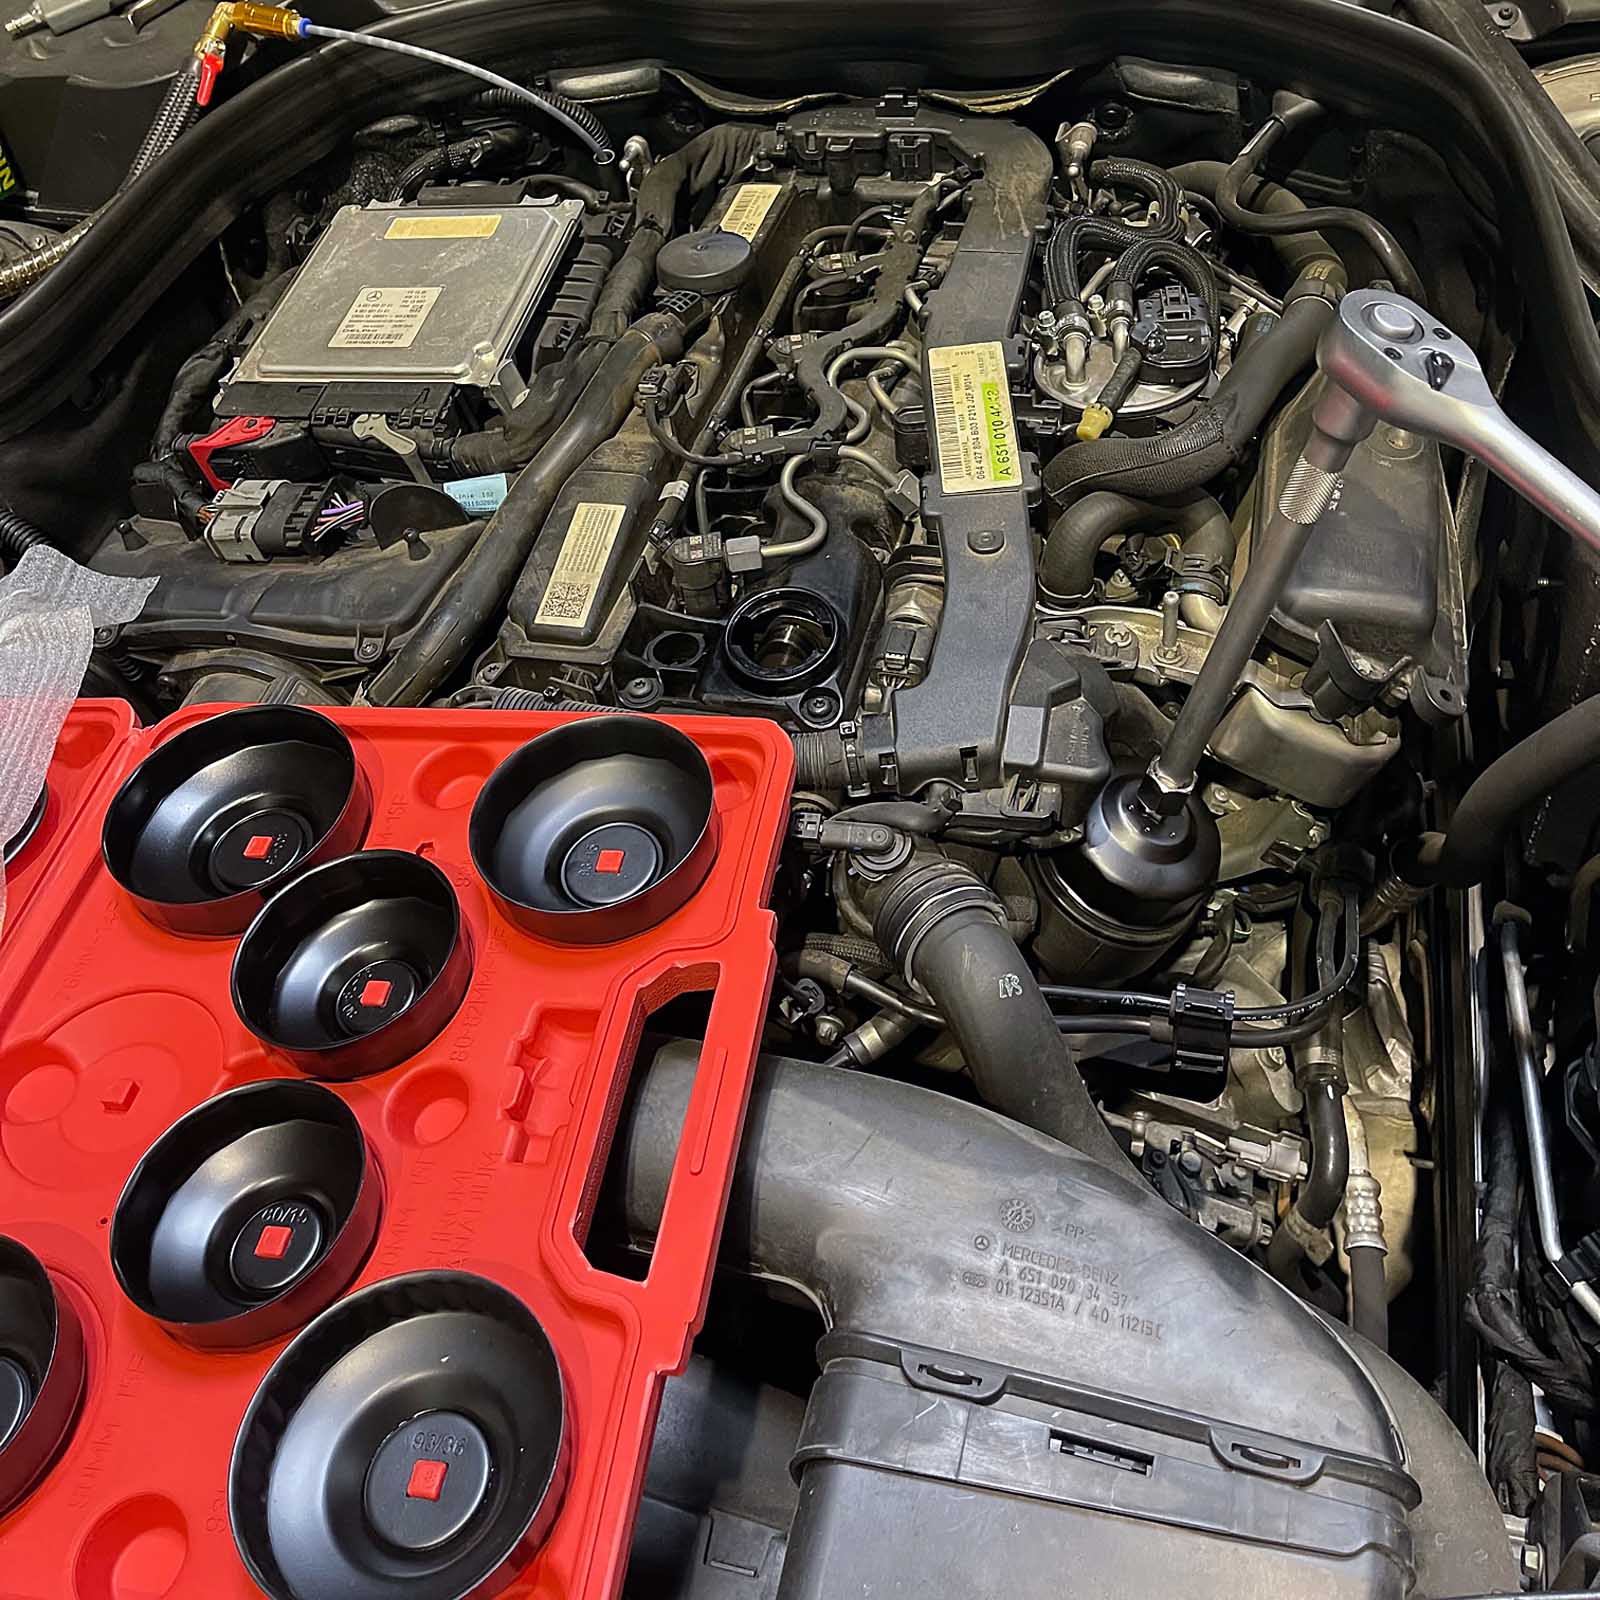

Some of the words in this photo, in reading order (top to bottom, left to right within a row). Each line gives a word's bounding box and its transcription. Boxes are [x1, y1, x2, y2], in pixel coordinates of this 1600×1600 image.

[996, 443, 1011, 464] 651
[999, 466, 1012, 476] A
[999, 1262, 1009, 1277] A
[1018, 1268, 1042, 1285] 651
[412, 1431, 466, 1457] 93/36
